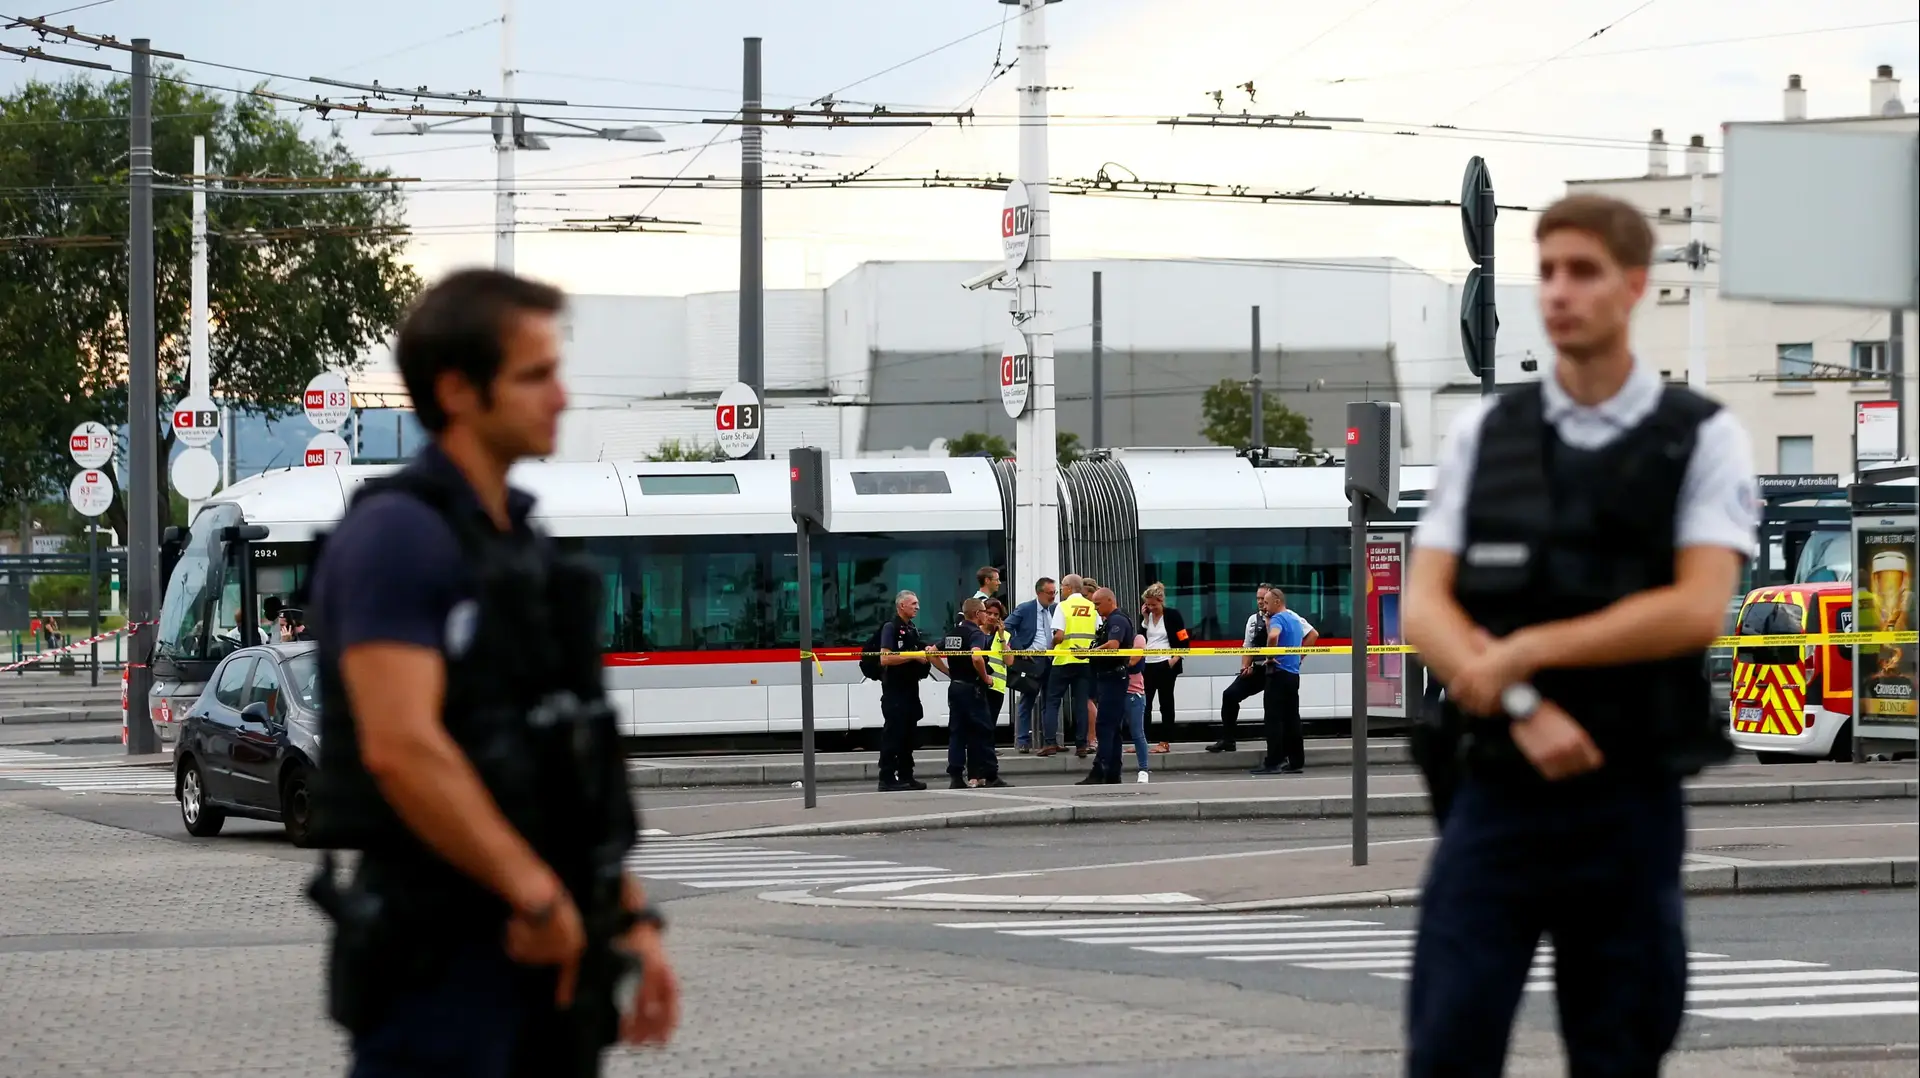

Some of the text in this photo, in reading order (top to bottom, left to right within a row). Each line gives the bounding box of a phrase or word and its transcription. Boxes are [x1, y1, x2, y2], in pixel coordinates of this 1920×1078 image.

[1004, 207, 1028, 234] C 17
[1003, 357, 1027, 382] C 11
[307, 392, 346, 407] BUS 83
[178, 411, 212, 427] C 8
[720, 406, 752, 428] C 3
[720, 432, 733, 441] Gare
[72, 437, 109, 449] BUS 57
[307, 453, 342, 465] BUS 7
[1759, 477, 1837, 488] Bonnevay Astroballe
[80, 485, 91, 495] 83
[83, 498, 88, 507] 7
[254, 549, 278, 558] 2924
[1879, 701, 1907, 712] BLONDE
